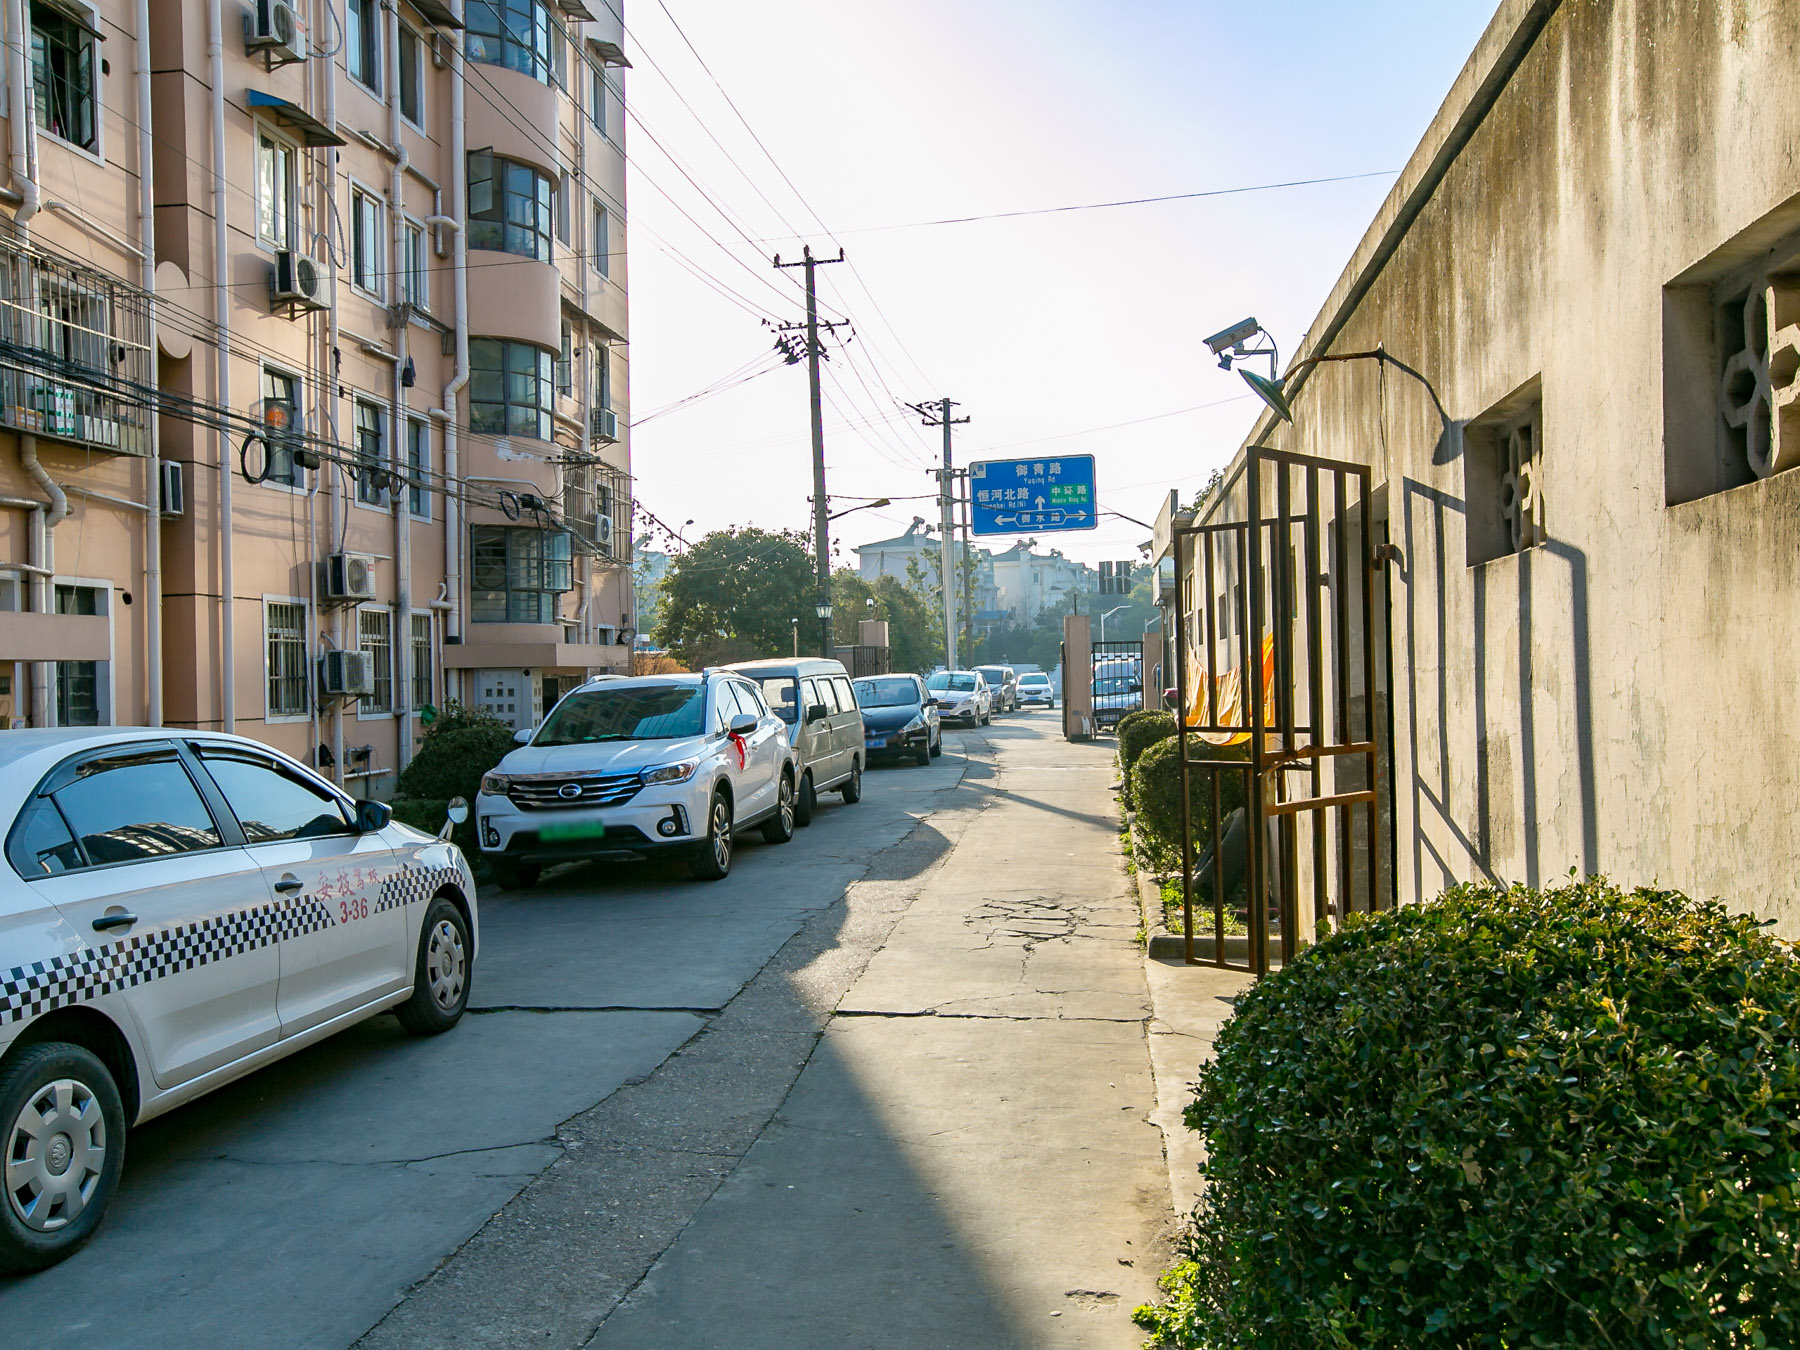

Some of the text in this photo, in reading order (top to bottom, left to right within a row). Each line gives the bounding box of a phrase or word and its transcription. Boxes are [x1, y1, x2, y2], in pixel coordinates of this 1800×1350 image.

[1016, 462, 1061, 477] 御青路
[1024, 477, 1045, 485] Yuqing
[977, 487, 1029, 502] 恒河北路
[1051, 485, 1087, 496] 中环路
[1021, 512, 1060, 523] 御水路
[340, 897, 368, 924] 3-36
